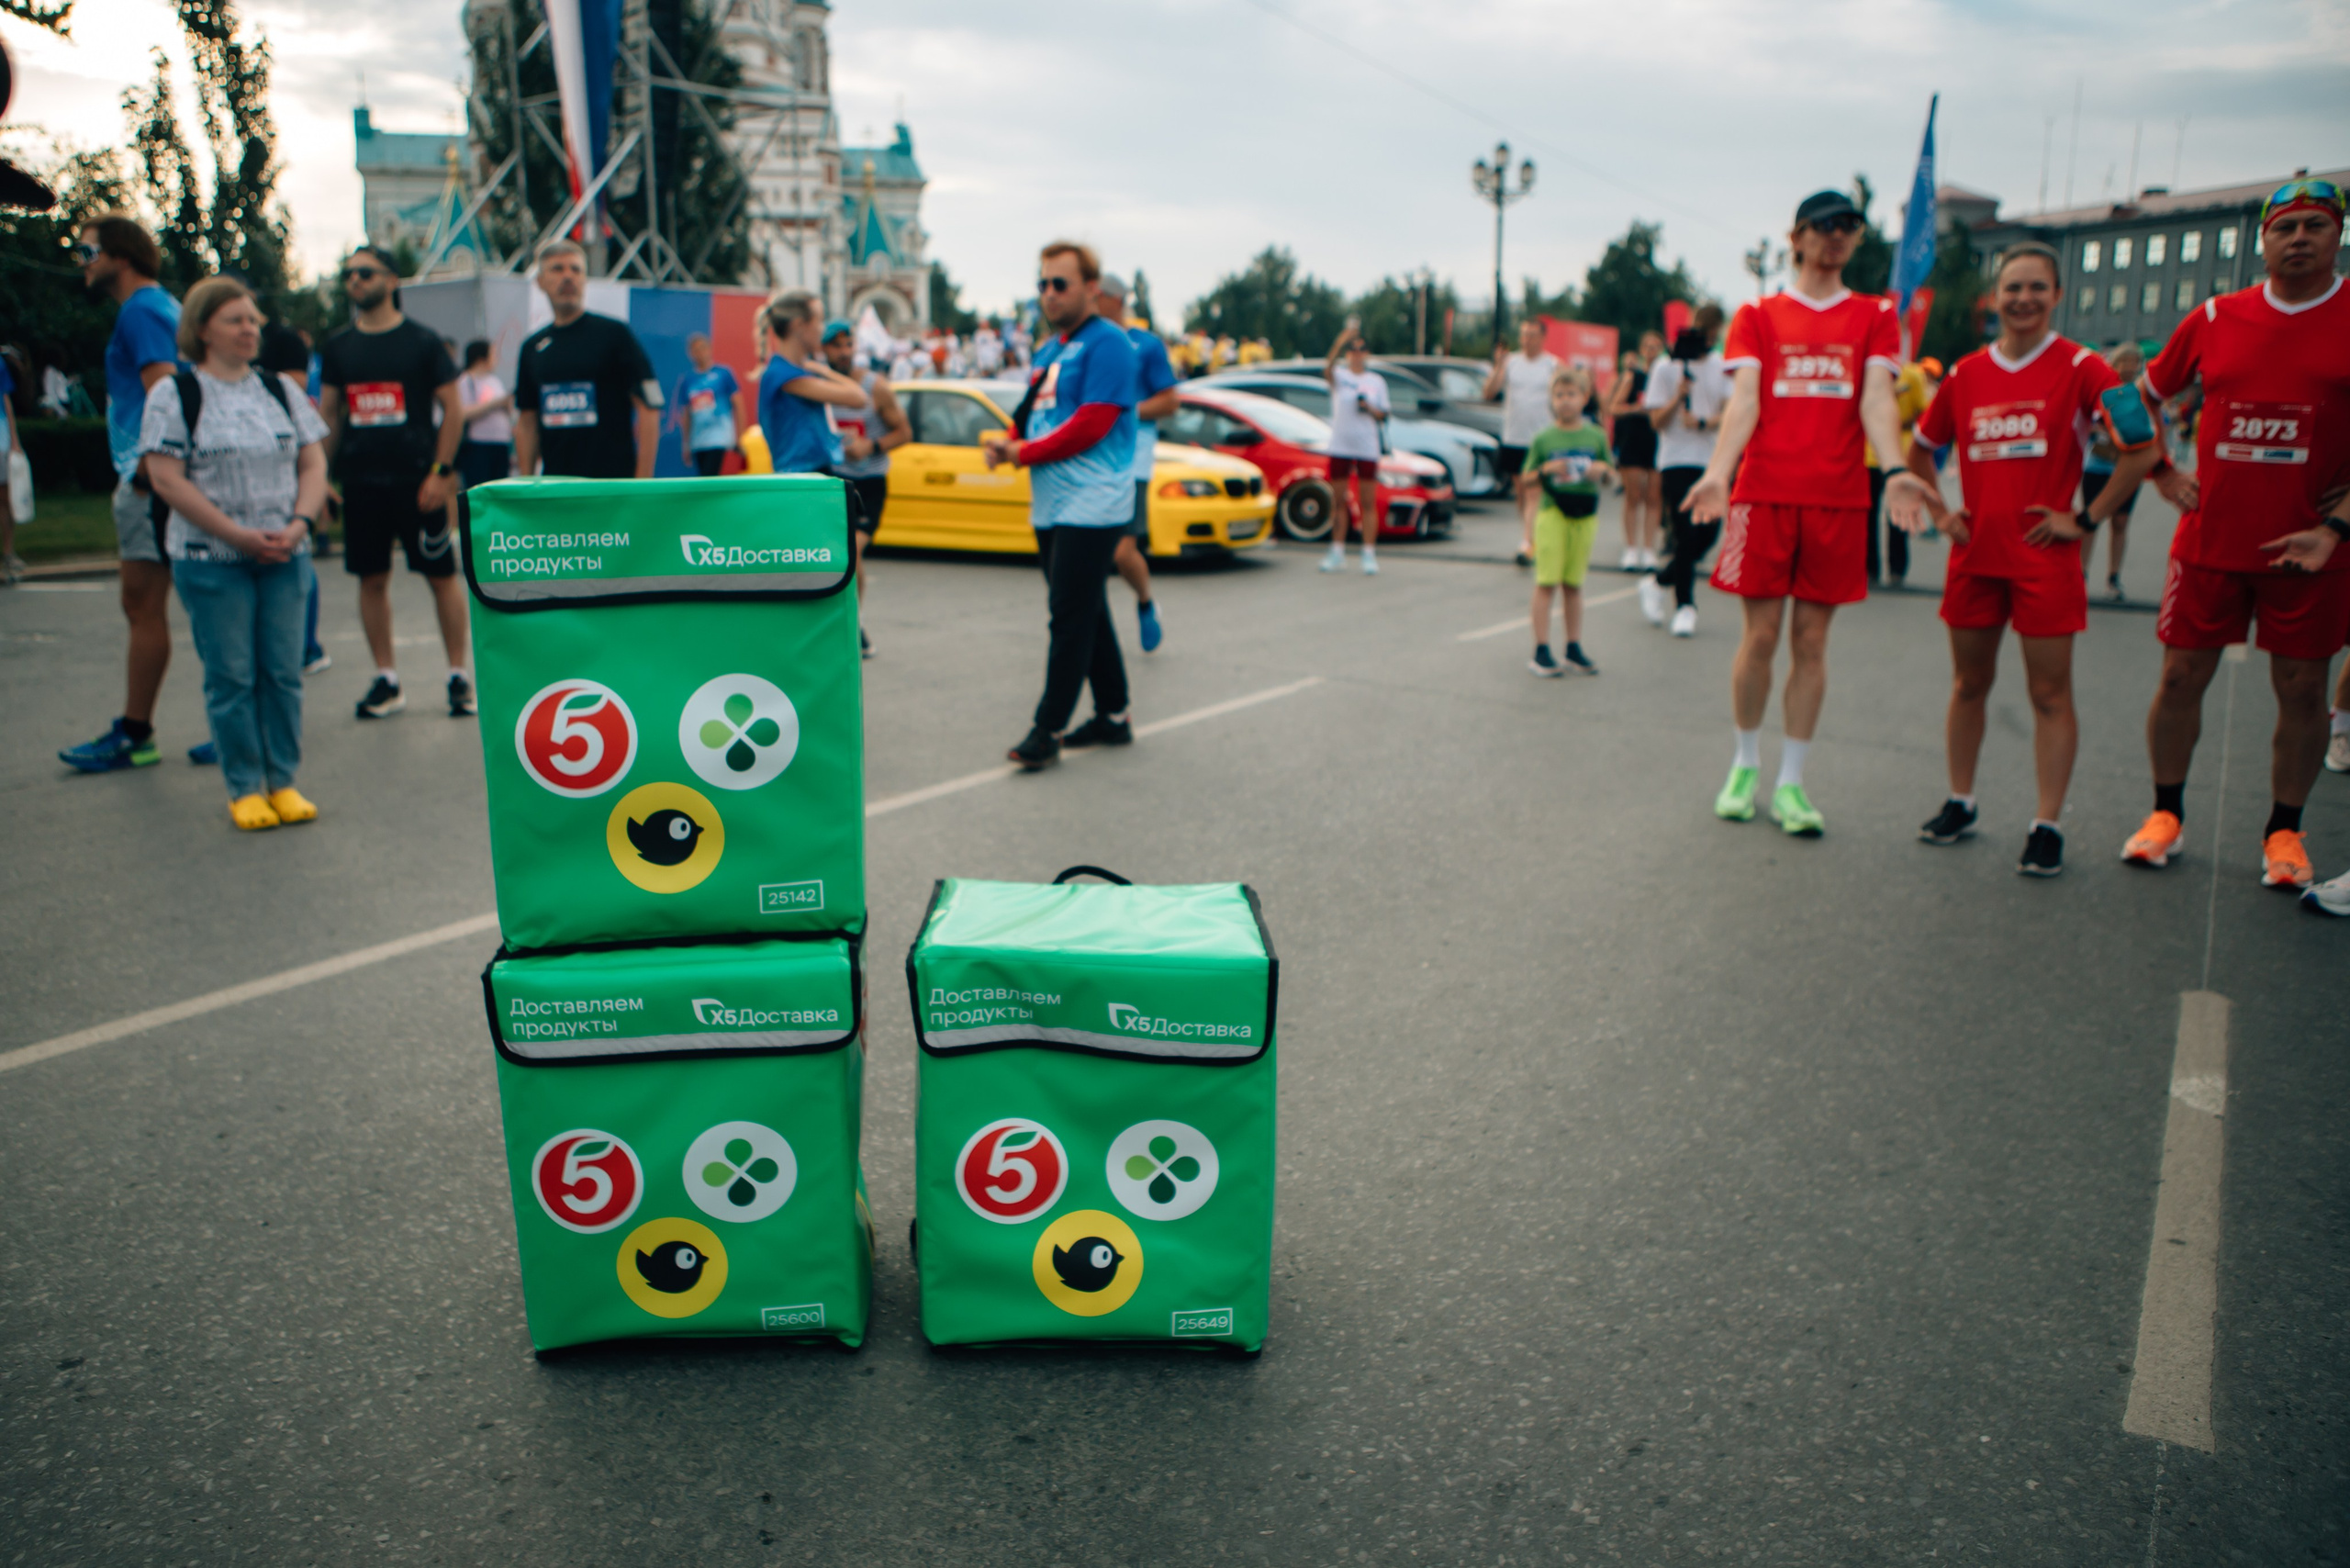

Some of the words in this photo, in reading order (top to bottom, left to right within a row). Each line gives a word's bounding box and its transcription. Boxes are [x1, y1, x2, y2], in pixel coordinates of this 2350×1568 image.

[488, 531, 630, 553] Доставляем
[490, 555, 602, 577] продукты
[549, 690, 608, 777] 5
[768, 889, 816, 905] 25142
[929, 988, 1061, 1006] Доставляем
[509, 998, 644, 1017] Доставляем
[931, 1006, 1034, 1027] продукты
[512, 1019, 618, 1039] продукты
[984, 1127, 1043, 1204] 5
[561, 1138, 616, 1215] 5
[768, 1311, 820, 1326] 25600
[1178, 1316, 1228, 1330] 25649
